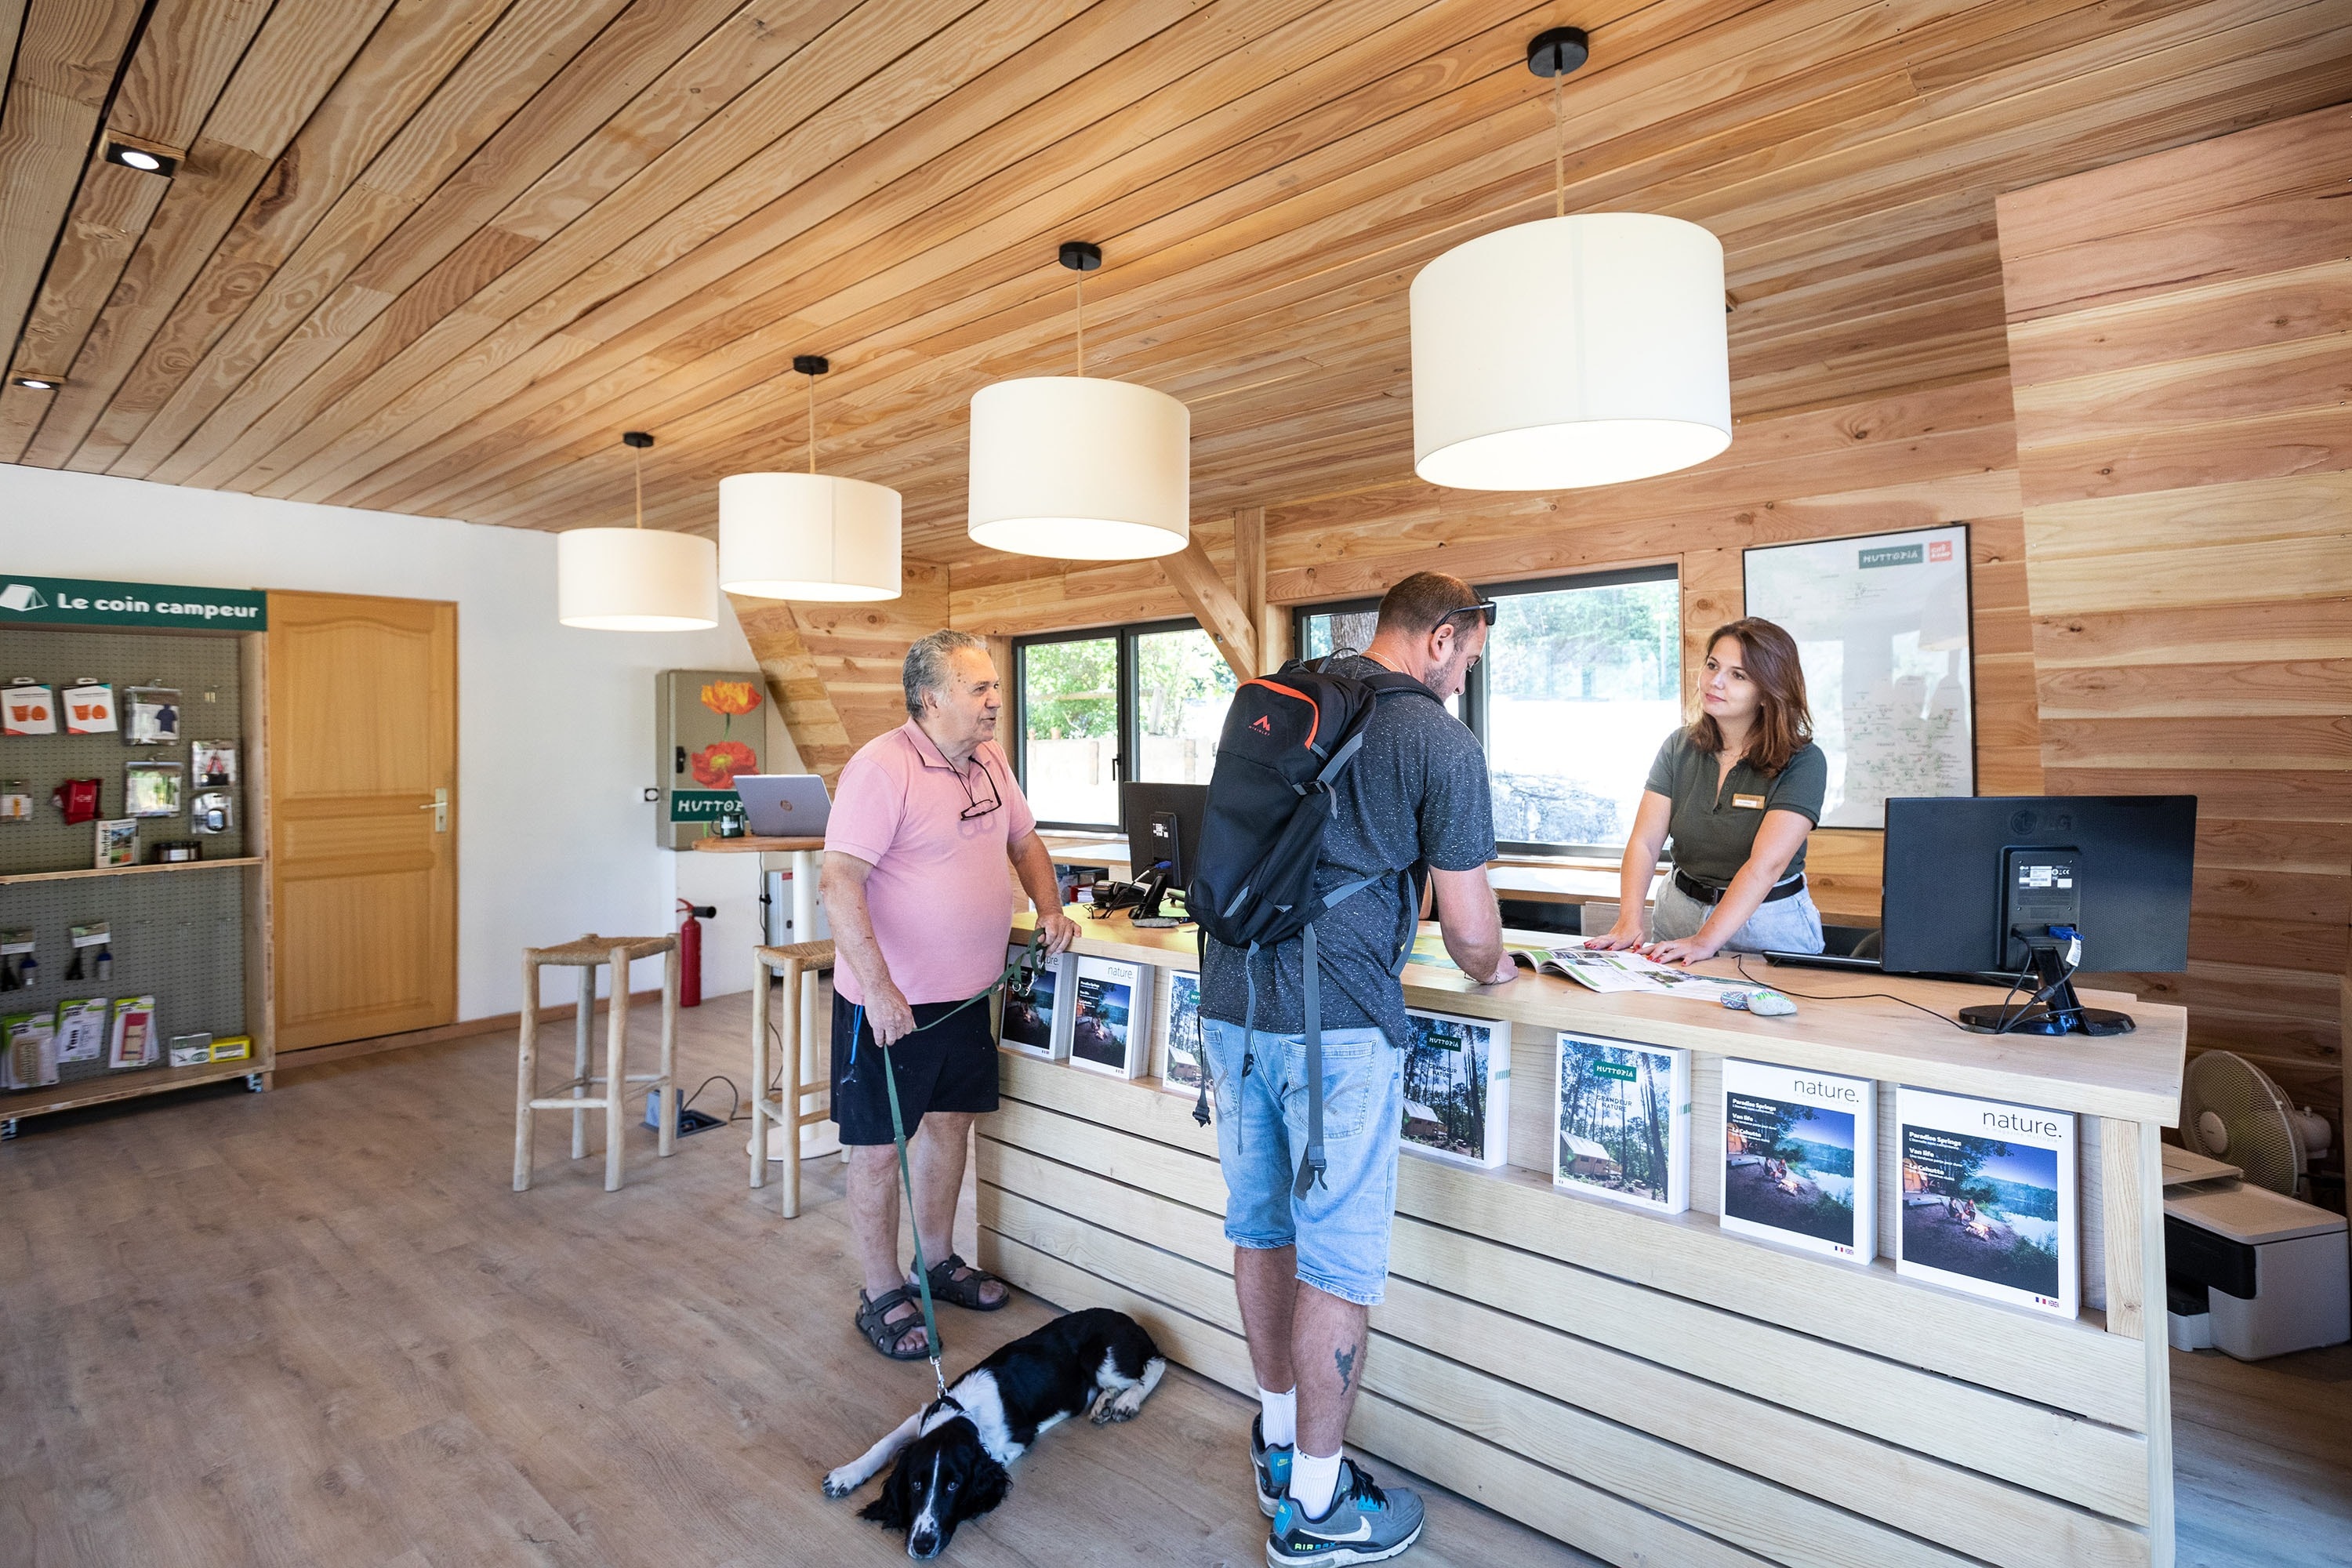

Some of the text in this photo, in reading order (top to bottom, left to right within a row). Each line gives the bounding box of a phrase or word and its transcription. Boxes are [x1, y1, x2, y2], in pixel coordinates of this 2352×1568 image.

[1863, 550, 1918, 563] HUTTOPIA
[57, 593, 259, 620] Le coin campeur
[677, 800, 744, 812] HUTTOP
[100, 829, 111, 857] Routard
[1036, 954, 1059, 966] nure.
[1429, 1036, 1459, 1047] HUTTOPIA
[1429, 1063, 1457, 1074] GRANDEUR
[1433, 1069, 1453, 1079] NATURE
[1596, 1065, 1633, 1077] HUTTOPIA
[1795, 1080, 1860, 1102] nature.
[1596, 1094, 1632, 1106] GRANDEUR
[1732, 1098, 1755, 1107] Paradise
[1755, 1102, 1777, 1112] Springs
[1602, 1102, 1627, 1112] NATURE
[1984, 1112, 2062, 1138] nature.
[1909, 1131, 1962, 1146] Paradise Springs
[1918, 1165, 1944, 1175] Cahutte
